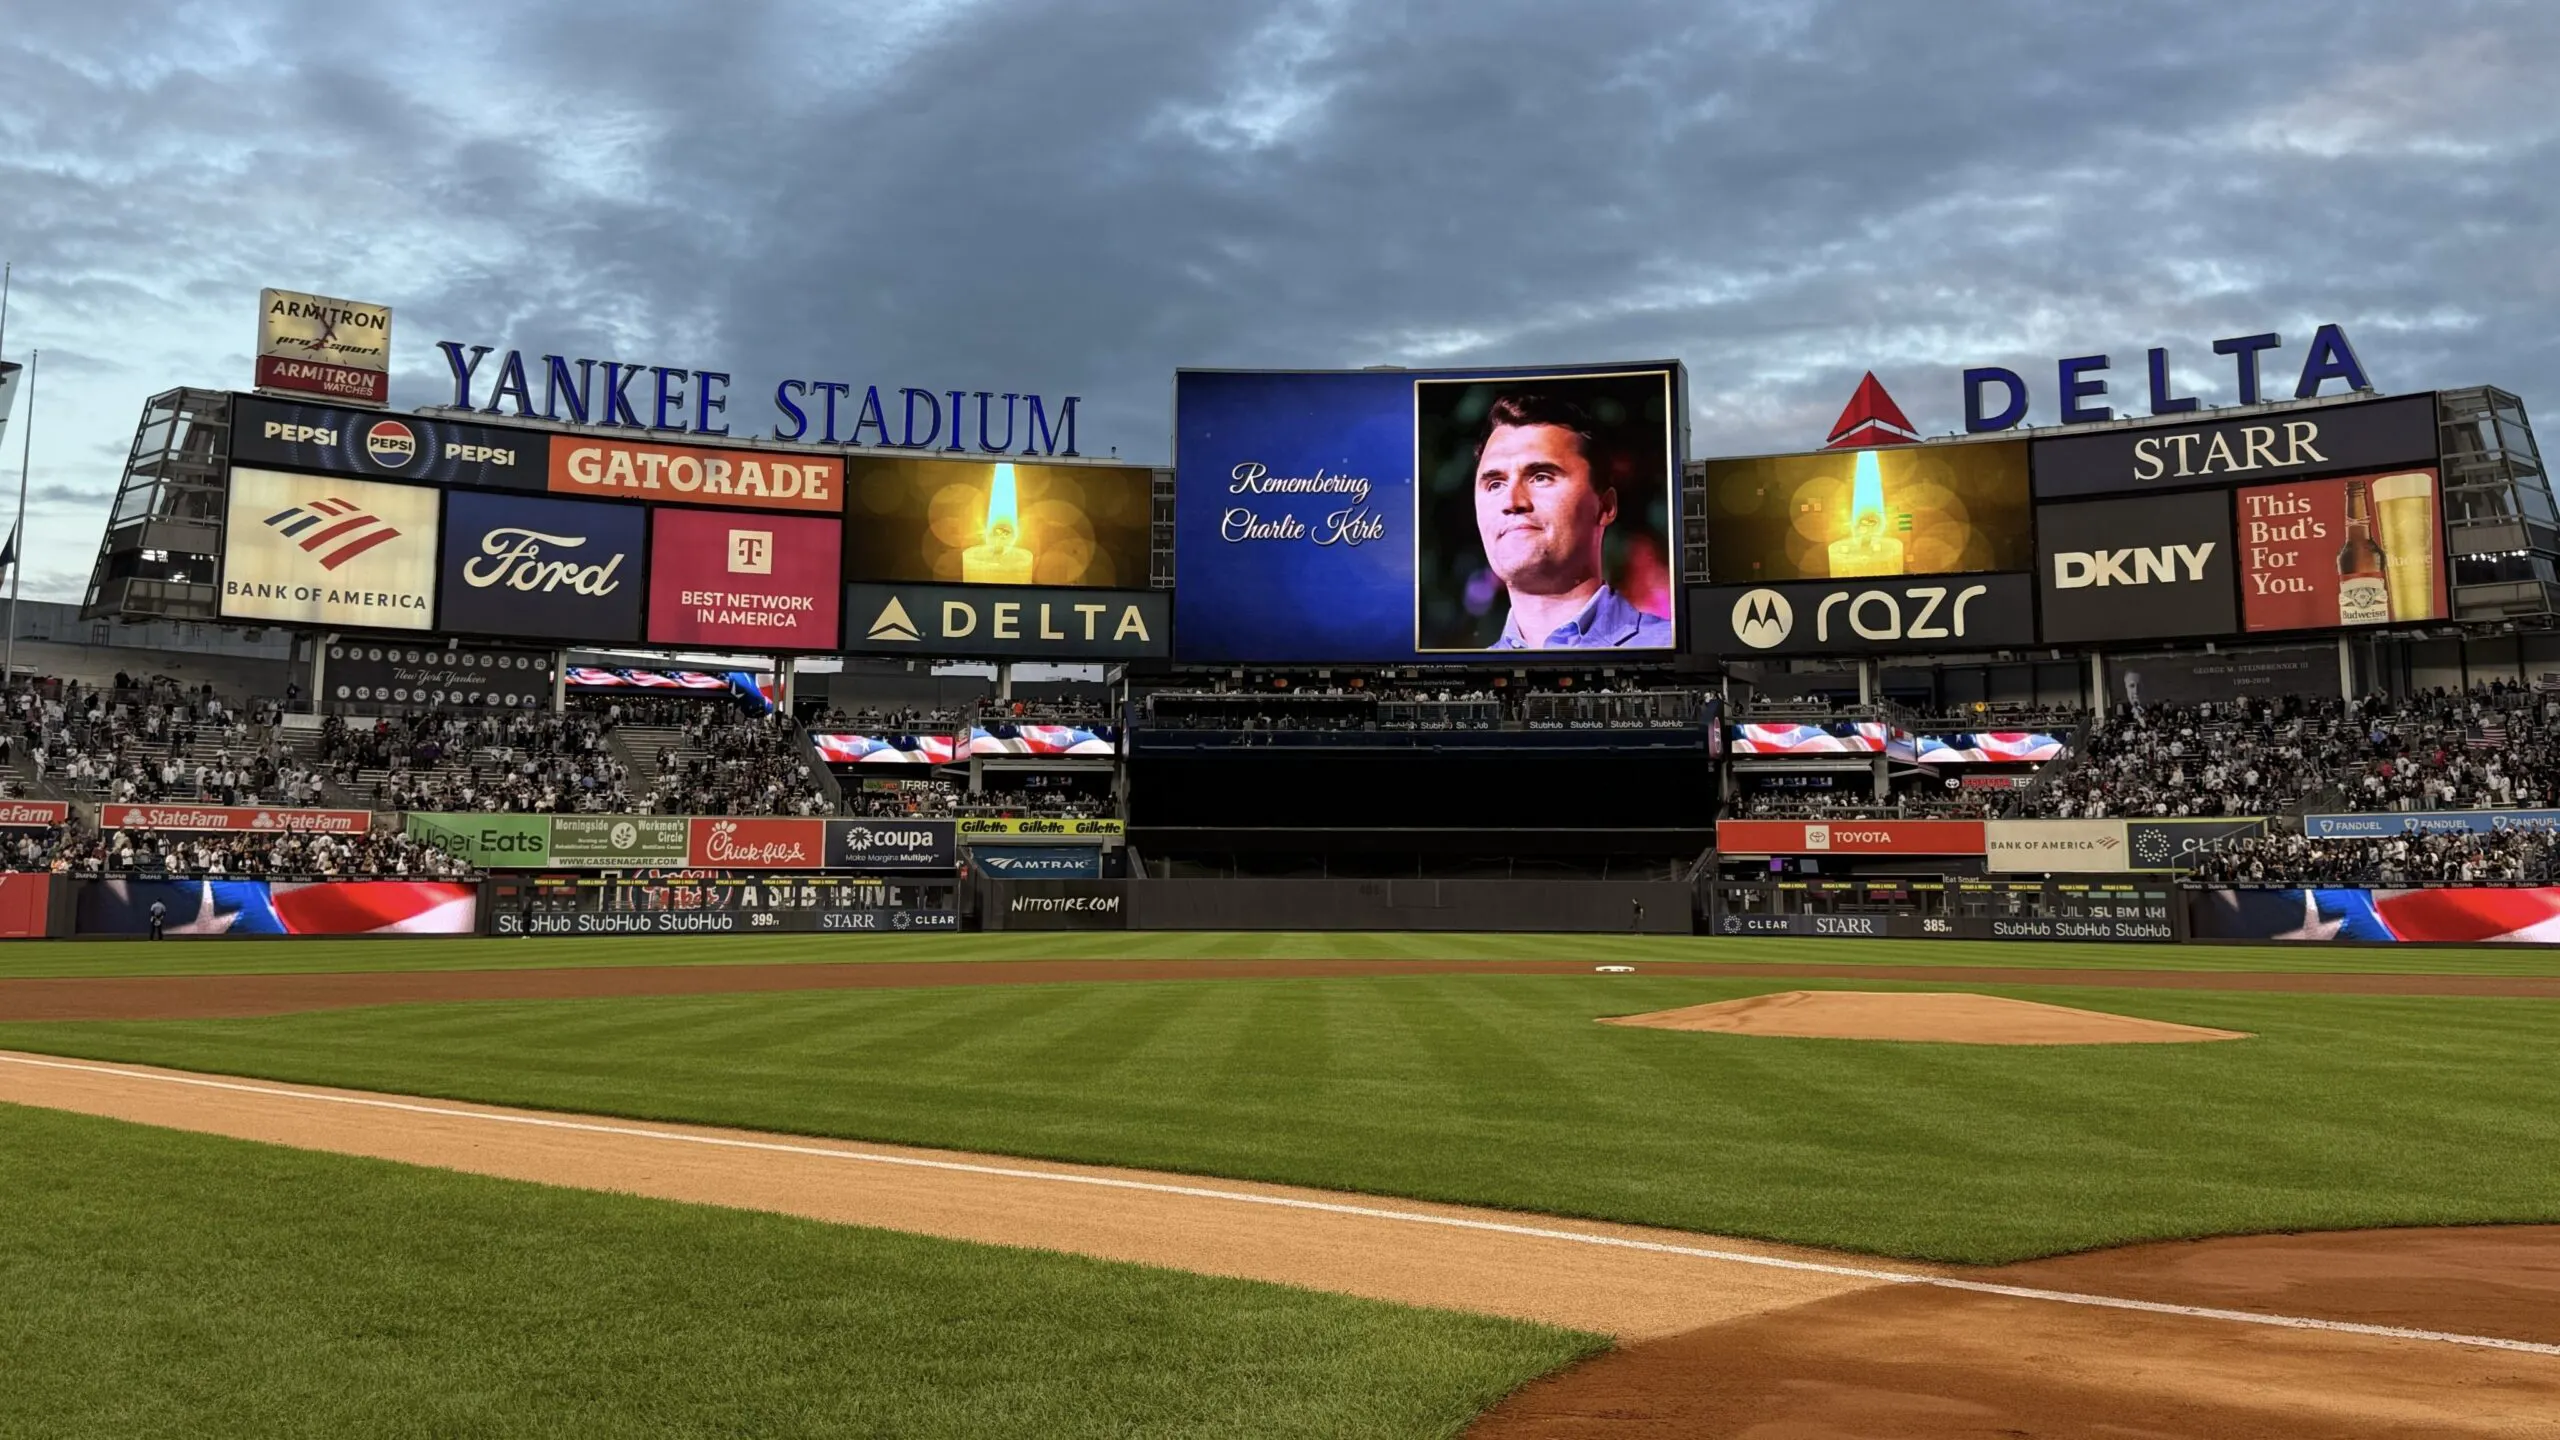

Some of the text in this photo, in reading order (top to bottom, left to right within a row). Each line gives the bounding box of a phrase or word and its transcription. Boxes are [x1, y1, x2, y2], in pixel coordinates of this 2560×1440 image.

[270, 299, 386, 330] ARMITRON
[329, 342, 381, 355] sport
[273, 361, 376, 388] ARMITRON
[1962, 322, 2373, 434] DELTA
[323, 381, 374, 396] WATCHES
[435, 340, 1082, 457] YANKEE STADIUM
[264, 420, 338, 446] PEPSI
[369, 437, 412, 451] PEPSI
[2133, 421, 2328, 481] STARR
[444, 443, 515, 466] PEPSI
[567, 446, 829, 501] GATORADE
[1229, 461, 1373, 504] Remembering
[2246, 492, 2312, 518] This
[1220, 504, 1385, 547] Charlie Kirk
[2249, 516, 2327, 544] Bud's
[462, 526, 626, 598] Ford
[2054, 541, 2217, 590] DKNY
[2250, 546, 2299, 570] For
[2251, 572, 2314, 596] You.
[227, 581, 427, 610] BANK OF AMERICA
[681, 590, 814, 611] BEST NETWORK
[697, 609, 798, 627] IN AMERICA
[942, 600, 1151, 642] DELTA
[1816, 584, 1987, 643] razr
[393, 667, 417, 680] New
[1529, 720, 1563, 729] StubHub
[1570, 720, 1603, 729] StubHub
[1610, 719, 1644, 728] StubHub
[1650, 719, 1683, 728] StubHub
[555, 819, 609, 833] Morningside
[961, 821, 1008, 834] Gillette
[1018, 821, 1064, 834] Gillette
[1075, 821, 1121, 834] Gillette
[2336, 821, 2383, 831] FANDUEL
[2420, 819, 2469, 829] FANDUEL
[480, 829, 544, 852] Eats
[657, 831, 684, 842] Circle
[873, 829, 934, 851] coupa
[1834, 831, 1892, 844] TOYOTA
[1990, 840, 2094, 850] BANK OF AMERICA
[558, 857, 679, 866] WWW.CASSENACARE.COM
[845, 853, 866, 861] Make
[867, 853, 899, 863] Margins
[1012, 859, 1085, 869] AMTRAK
[1011, 895, 1120, 913] NITTOTIRE.COM
[578, 914, 651, 932] StubHub
[659, 913, 733, 930] StubHub
[823, 914, 875, 928] STARR
[915, 915, 955, 925] CLEAR
[1748, 920, 1788, 929] CLEAR
[1816, 917, 1873, 933] STARR
[1993, 921, 2050, 936] StubHub
[2055, 922, 2111, 937] StubHub
[2115, 922, 2171, 937] StubHub
